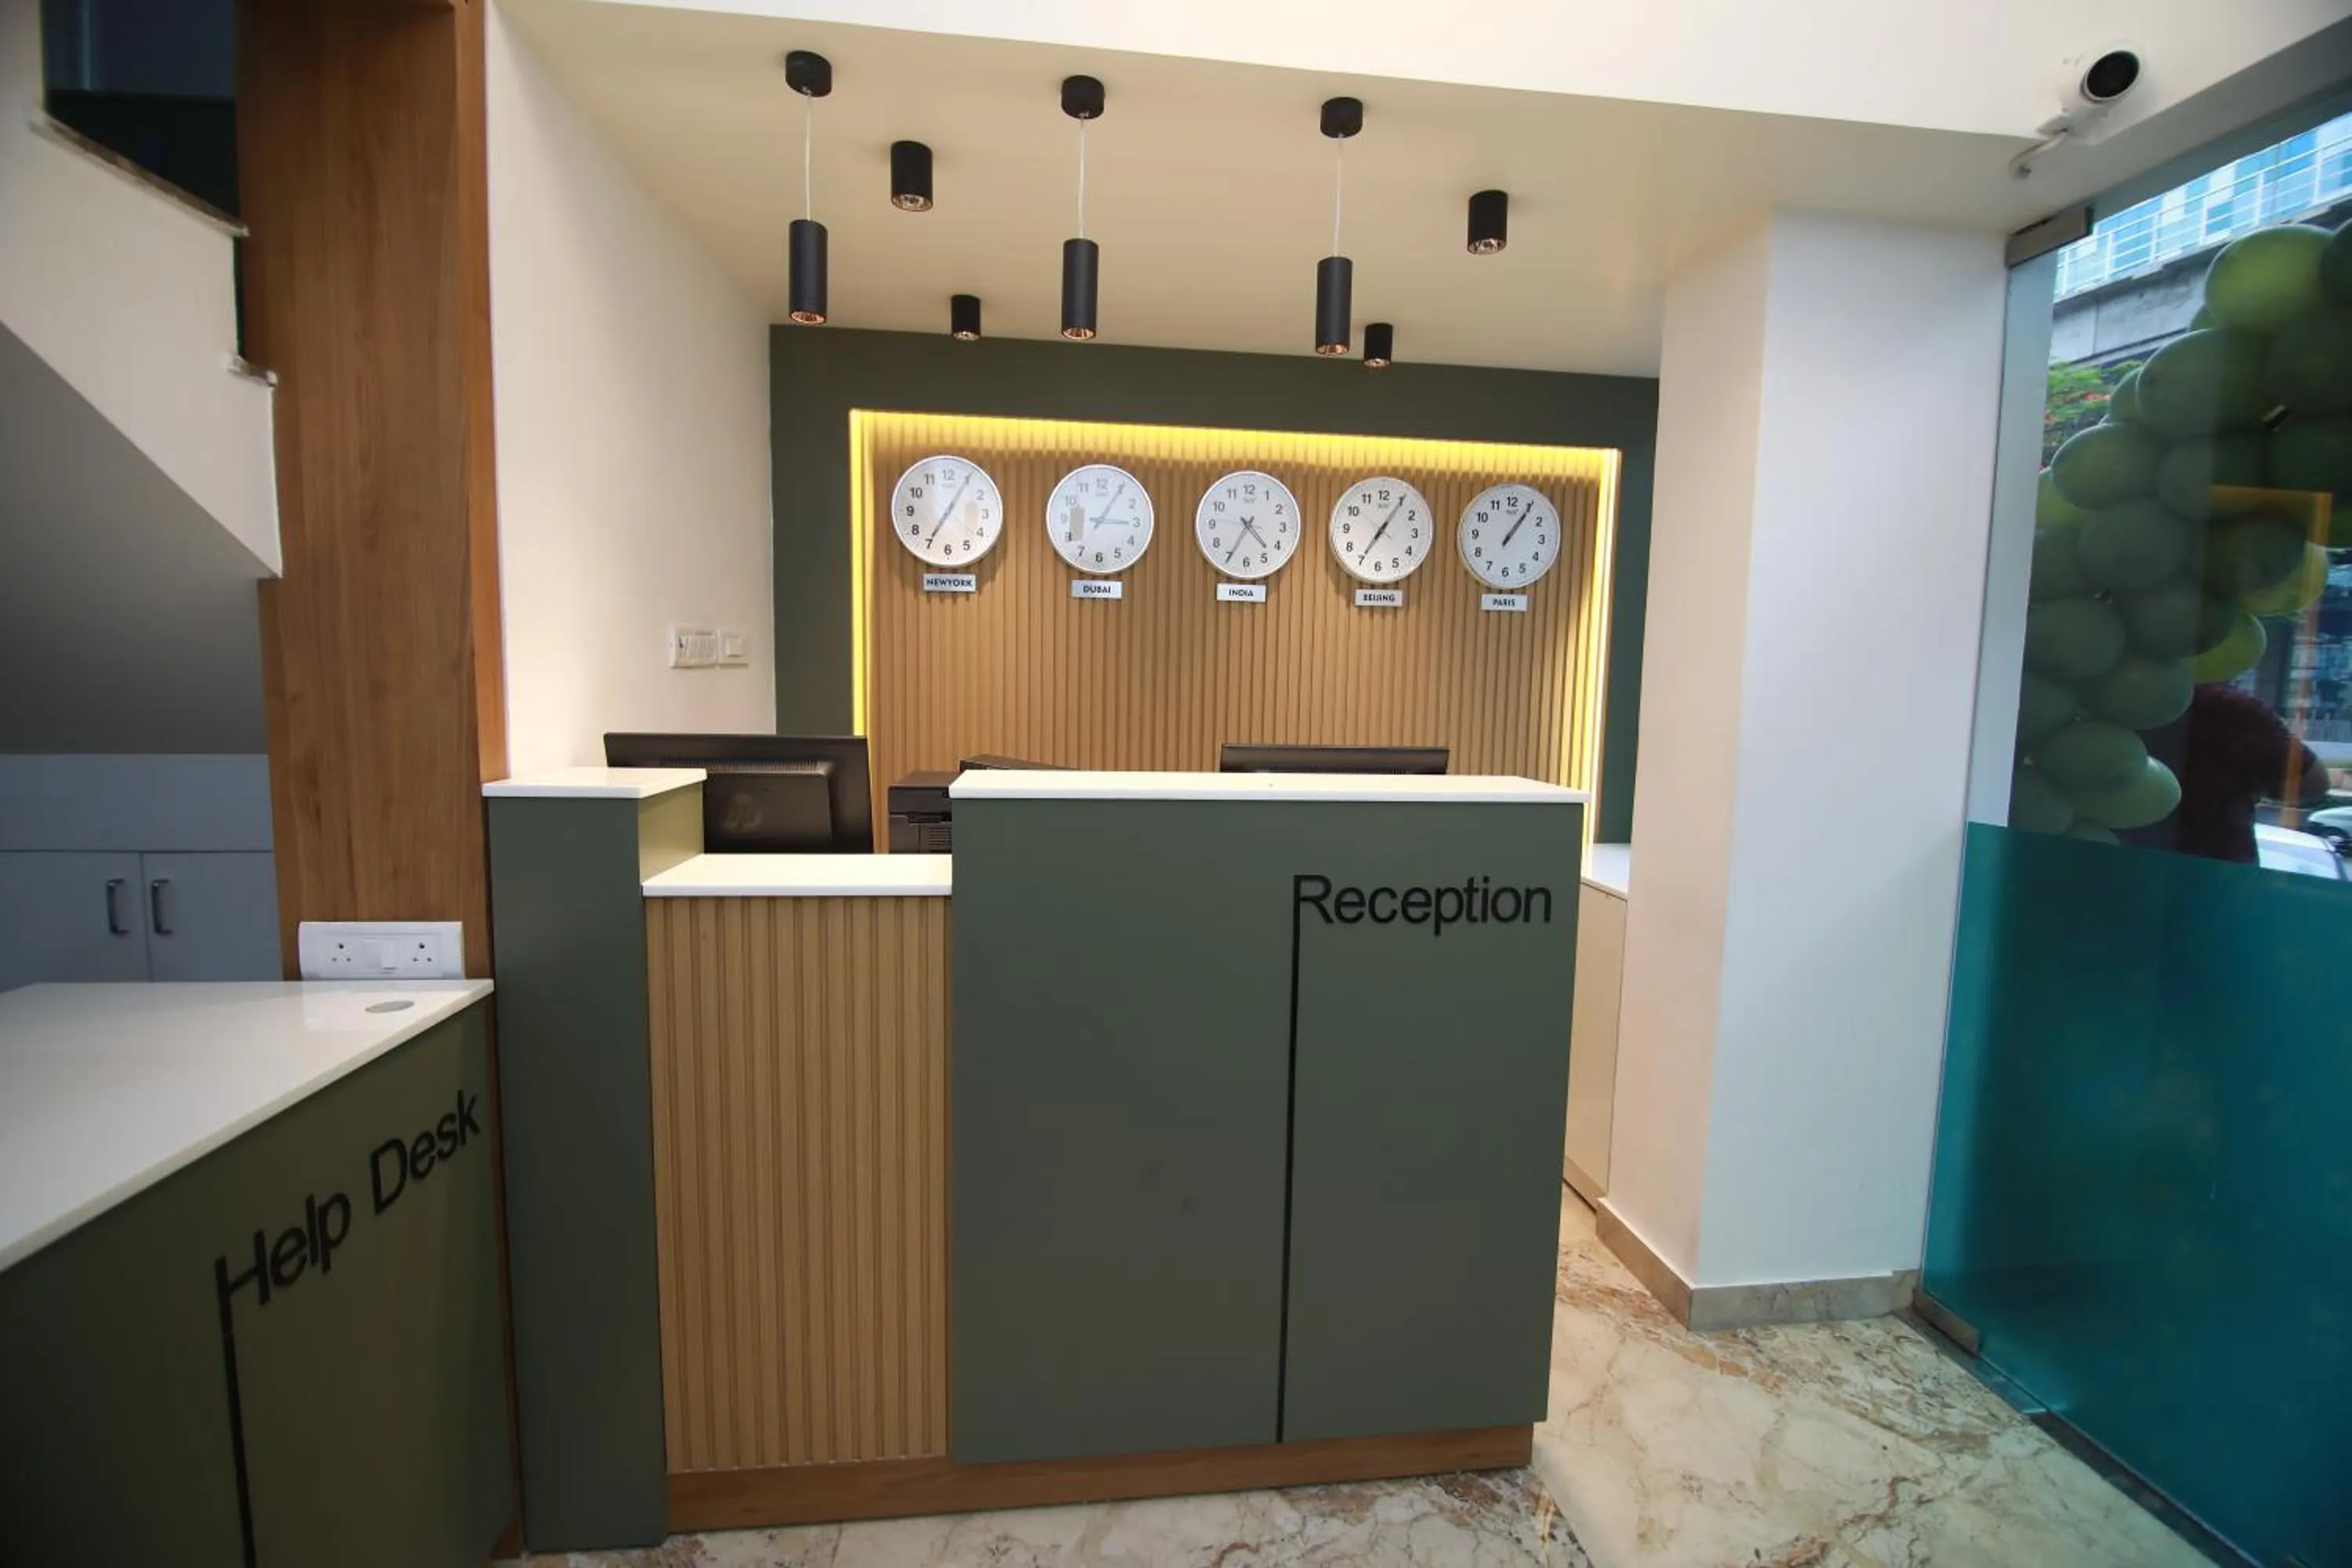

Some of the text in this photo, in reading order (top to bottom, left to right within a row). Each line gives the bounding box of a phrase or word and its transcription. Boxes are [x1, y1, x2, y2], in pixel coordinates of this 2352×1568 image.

[925, 474, 935, 485] 11
[942, 469, 955, 481] 12
[1079, 483, 1089, 493] 11
[1096, 478, 1108, 490] 12
[909, 487, 923, 499] 10
[976, 489, 984, 501] 2
[1227, 489, 1236, 499] 11
[1243, 485, 1255, 495] 12
[1378, 490, 1390, 501] 12
[1065, 495, 1076, 506] 10
[1362, 493, 1371, 504] 11
[1507, 496, 1519, 507] 12
[1129, 499, 1136, 510] 2
[1214, 502, 1225, 512] 10
[1276, 503, 1283, 514] 2
[1490, 500, 1501, 510] 11
[906, 505, 915, 517] 9
[982, 509, 989, 520] 3
[1348, 506, 1359, 517] 10
[1408, 510, 1415, 521] 2
[1133, 517, 1141, 528] 3
[1477, 512, 1489, 523] 10
[1536, 517, 1543, 527] 2
[912, 524, 920, 535] 8
[1208, 519, 1216, 529] 9
[1279, 522, 1287, 533] 3
[1343, 523, 1350, 533] 9
[976, 528, 984, 537] 4
[1411, 528, 1418, 539] 3
[1472, 529, 1479, 539] 9
[925, 539, 933, 549] 7
[964, 540, 971, 550] 5
[1127, 535, 1135, 546] 4
[1213, 538, 1221, 548] 8
[1274, 540, 1280, 550] 4
[1537, 535, 1545, 544] 3
[944, 544, 952, 556] 6
[1078, 546, 1086, 557] 7
[1346, 542, 1353, 552] 8
[1405, 546, 1412, 556] 4
[1475, 547, 1481, 557] 8
[1095, 551, 1103, 563] 6
[1114, 548, 1122, 558] 5
[1226, 551, 1233, 562] 7
[1532, 551, 1539, 561] 4
[1243, 557, 1250, 568] 6
[1260, 554, 1268, 564] 5
[1358, 554, 1365, 564] 7
[1392, 557, 1399, 568] 5
[1374, 561, 1381, 572] 6
[1486, 561, 1493, 571] 7
[1519, 563, 1526, 573] 5
[1501, 567, 1509, 577] 6
[926, 578, 972, 587] NEWYORK
[1083, 585, 1111, 593] DUBAI
[1293, 874, 1552, 937] Reception
[214, 1089, 481, 1307] Help Desk
